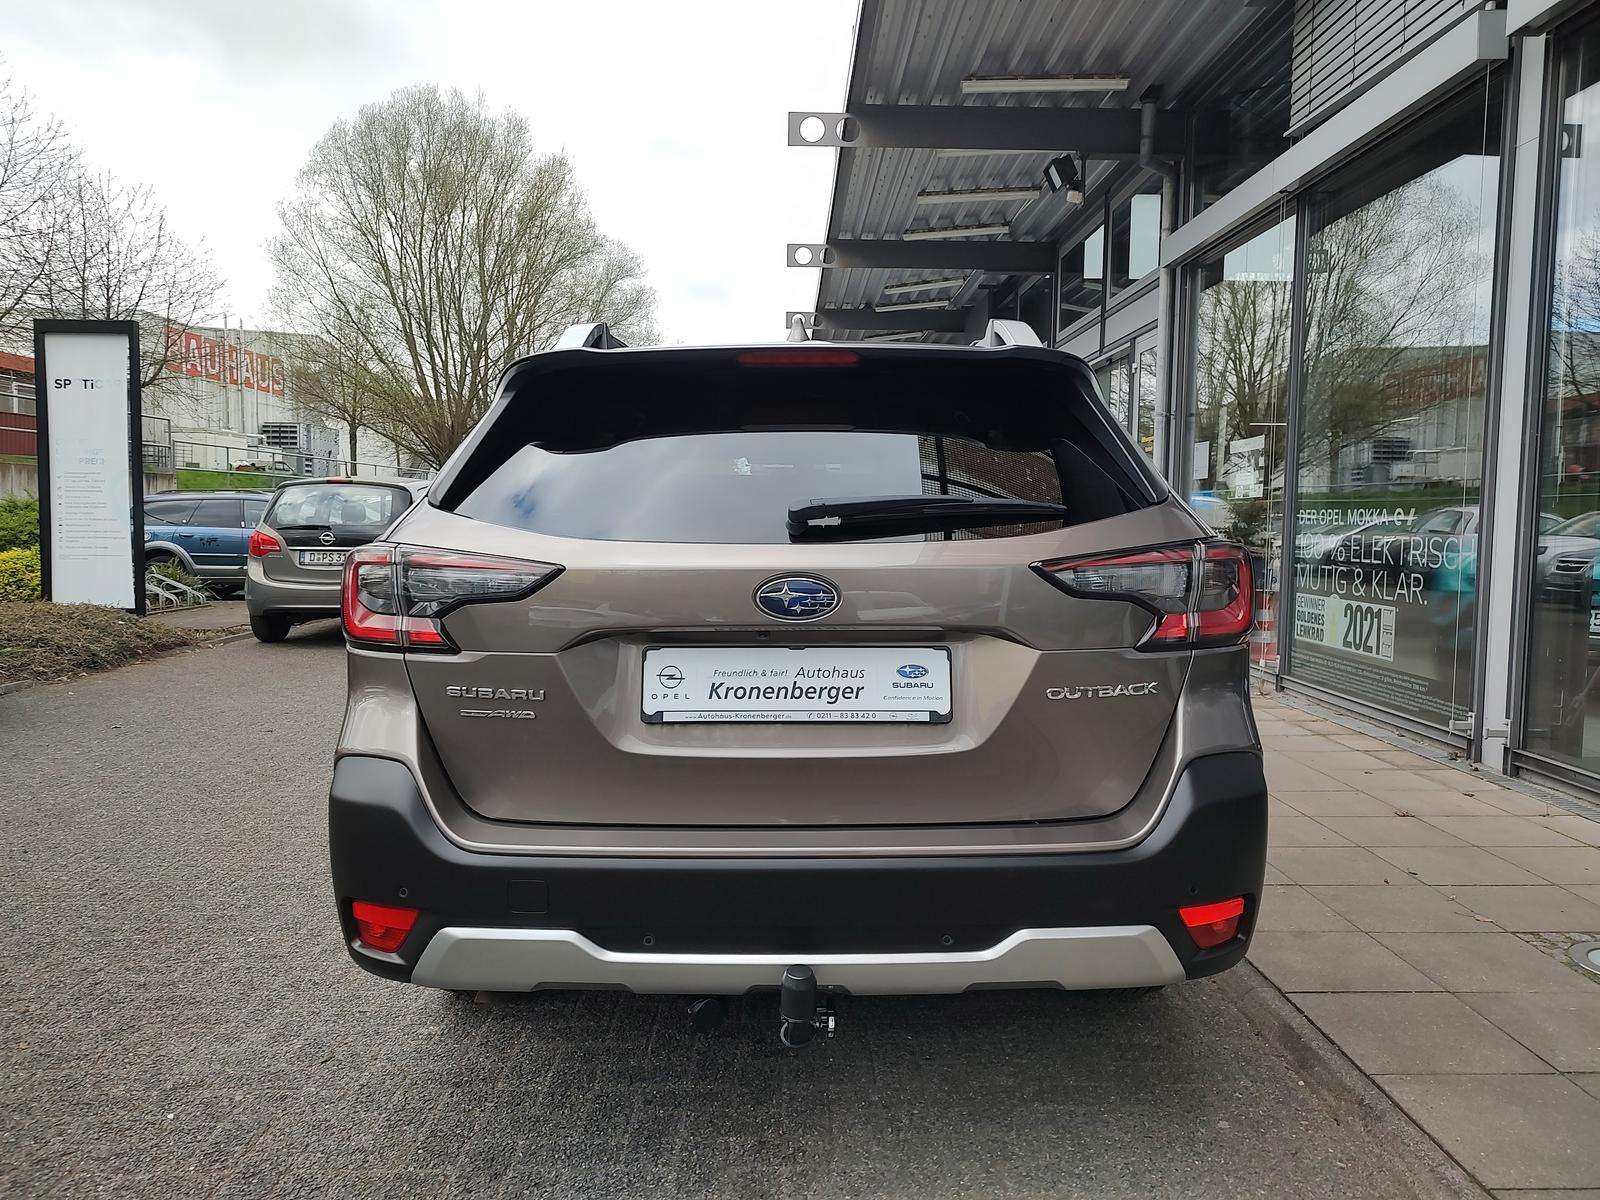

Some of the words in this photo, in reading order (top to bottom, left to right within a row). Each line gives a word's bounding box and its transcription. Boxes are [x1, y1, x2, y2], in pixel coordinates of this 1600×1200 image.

[1299, 508, 1317, 525] DER
[1319, 508, 1345, 526] OPEL
[1347, 508, 1390, 526] MOKKA
[335, 553, 347, 562] 31
[1296, 564, 1348, 594] MUTIG
[1352, 567, 1366, 598] &
[1371, 569, 1428, 606] KLAR.
[1296, 595, 1326, 612] GEWINNER
[1296, 609, 1325, 627] GOLDENES
[1296, 623, 1325, 642] LENKRAD
[1342, 602, 1382, 656] 2021
[713, 669, 758, 677] Freundlich
[760, 669, 767, 677] &
[770, 669, 788, 677] fair!
[794, 666, 865, 679] Autohaus
[446, 685, 545, 701] SUBARU
[708, 681, 865, 704] Kronenberger
[1046, 681, 1159, 700] OUTBACK
[486, 709, 537, 719] AWD
